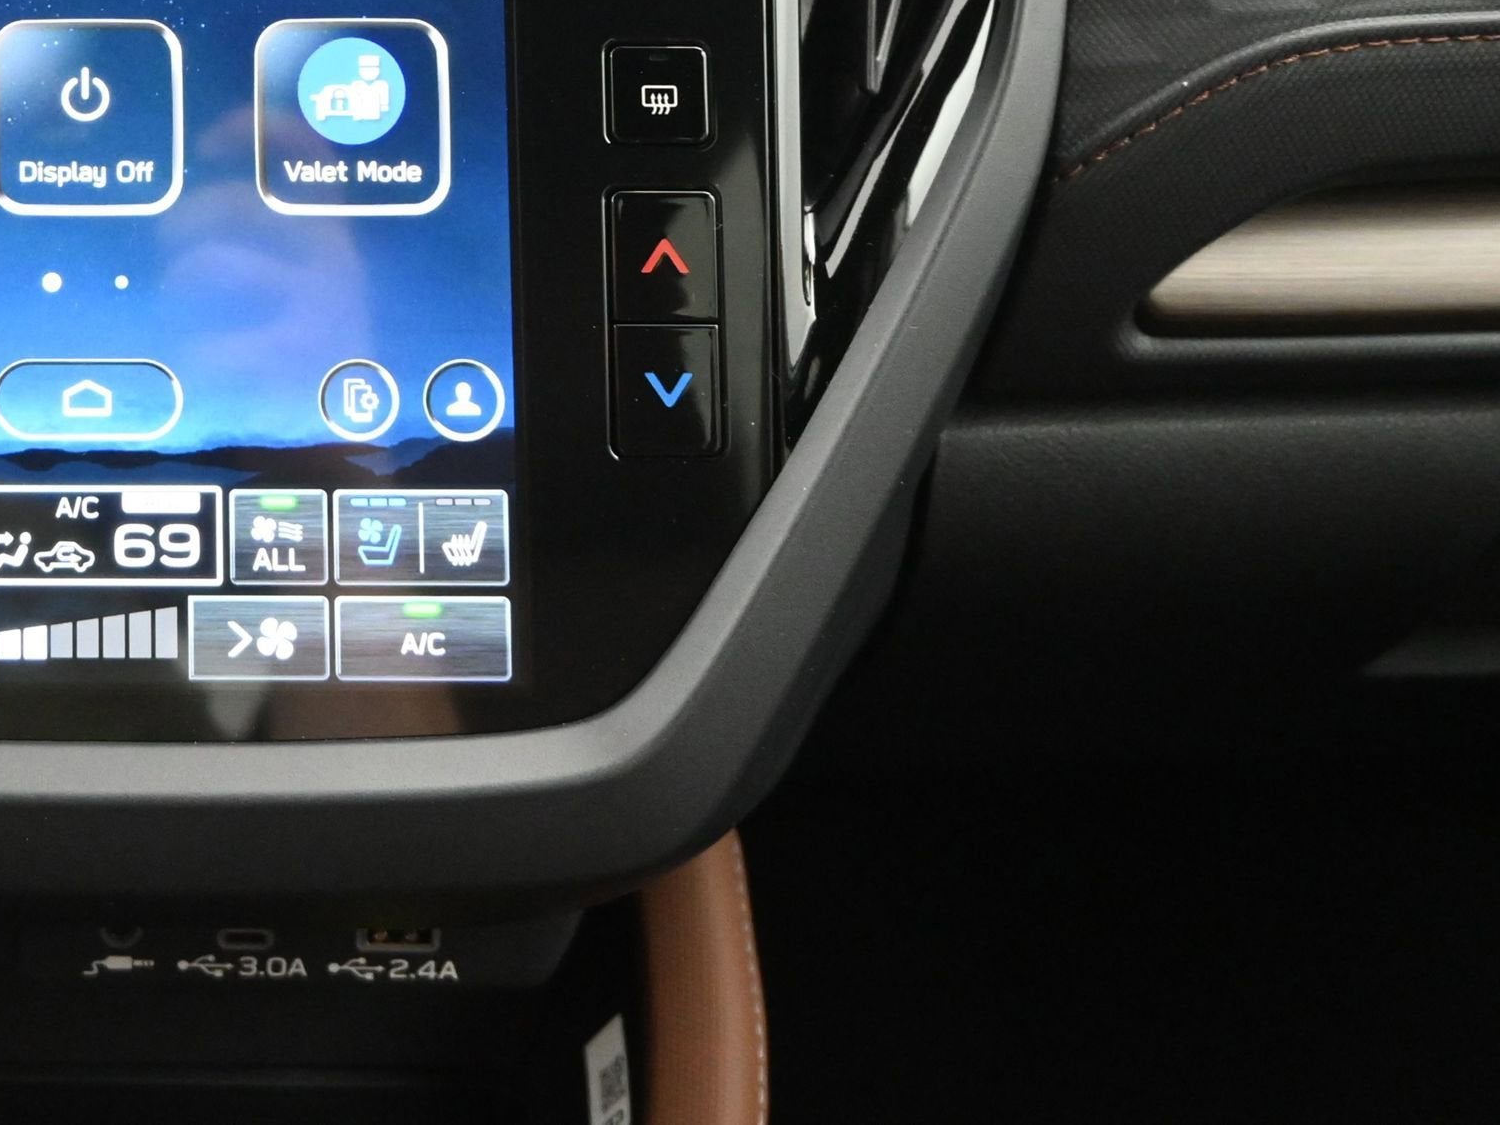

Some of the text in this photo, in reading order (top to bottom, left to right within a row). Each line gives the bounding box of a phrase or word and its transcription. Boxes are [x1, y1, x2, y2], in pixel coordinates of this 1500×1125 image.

[19, 161, 155, 188] Display Off
[284, 161, 423, 184] Valet Mode
[55, 497, 100, 520] A/C
[112, 525, 202, 569] 69
[252, 547, 307, 572] ALL
[400, 632, 447, 657] A/C
[238, 957, 308, 976] 3.0A
[389, 960, 459, 980] 2.4A
